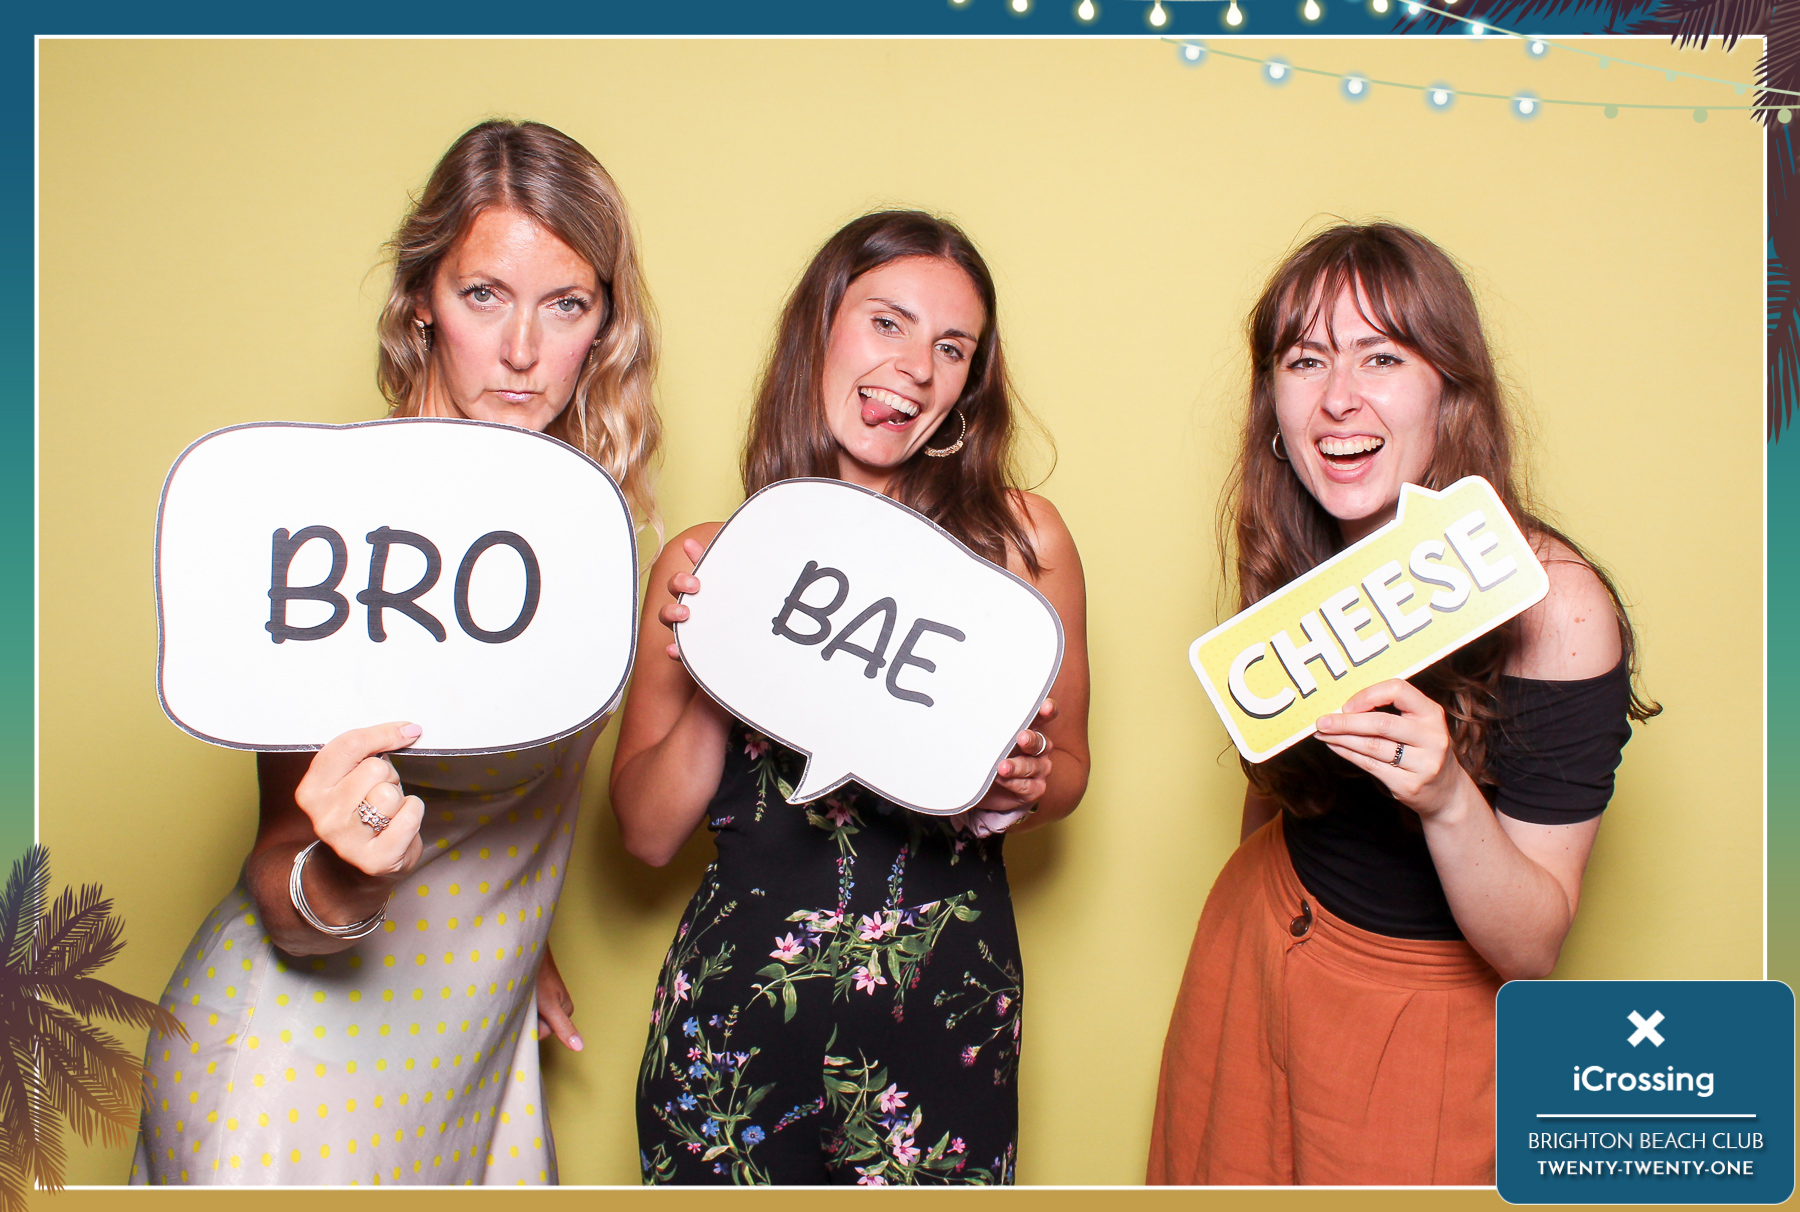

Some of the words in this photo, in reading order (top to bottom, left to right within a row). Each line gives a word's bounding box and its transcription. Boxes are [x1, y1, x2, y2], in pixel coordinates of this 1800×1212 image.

[265, 525, 541, 644] BRO
[772, 560, 966, 707] BAE
[1228, 509, 1518, 720] CHEESE
